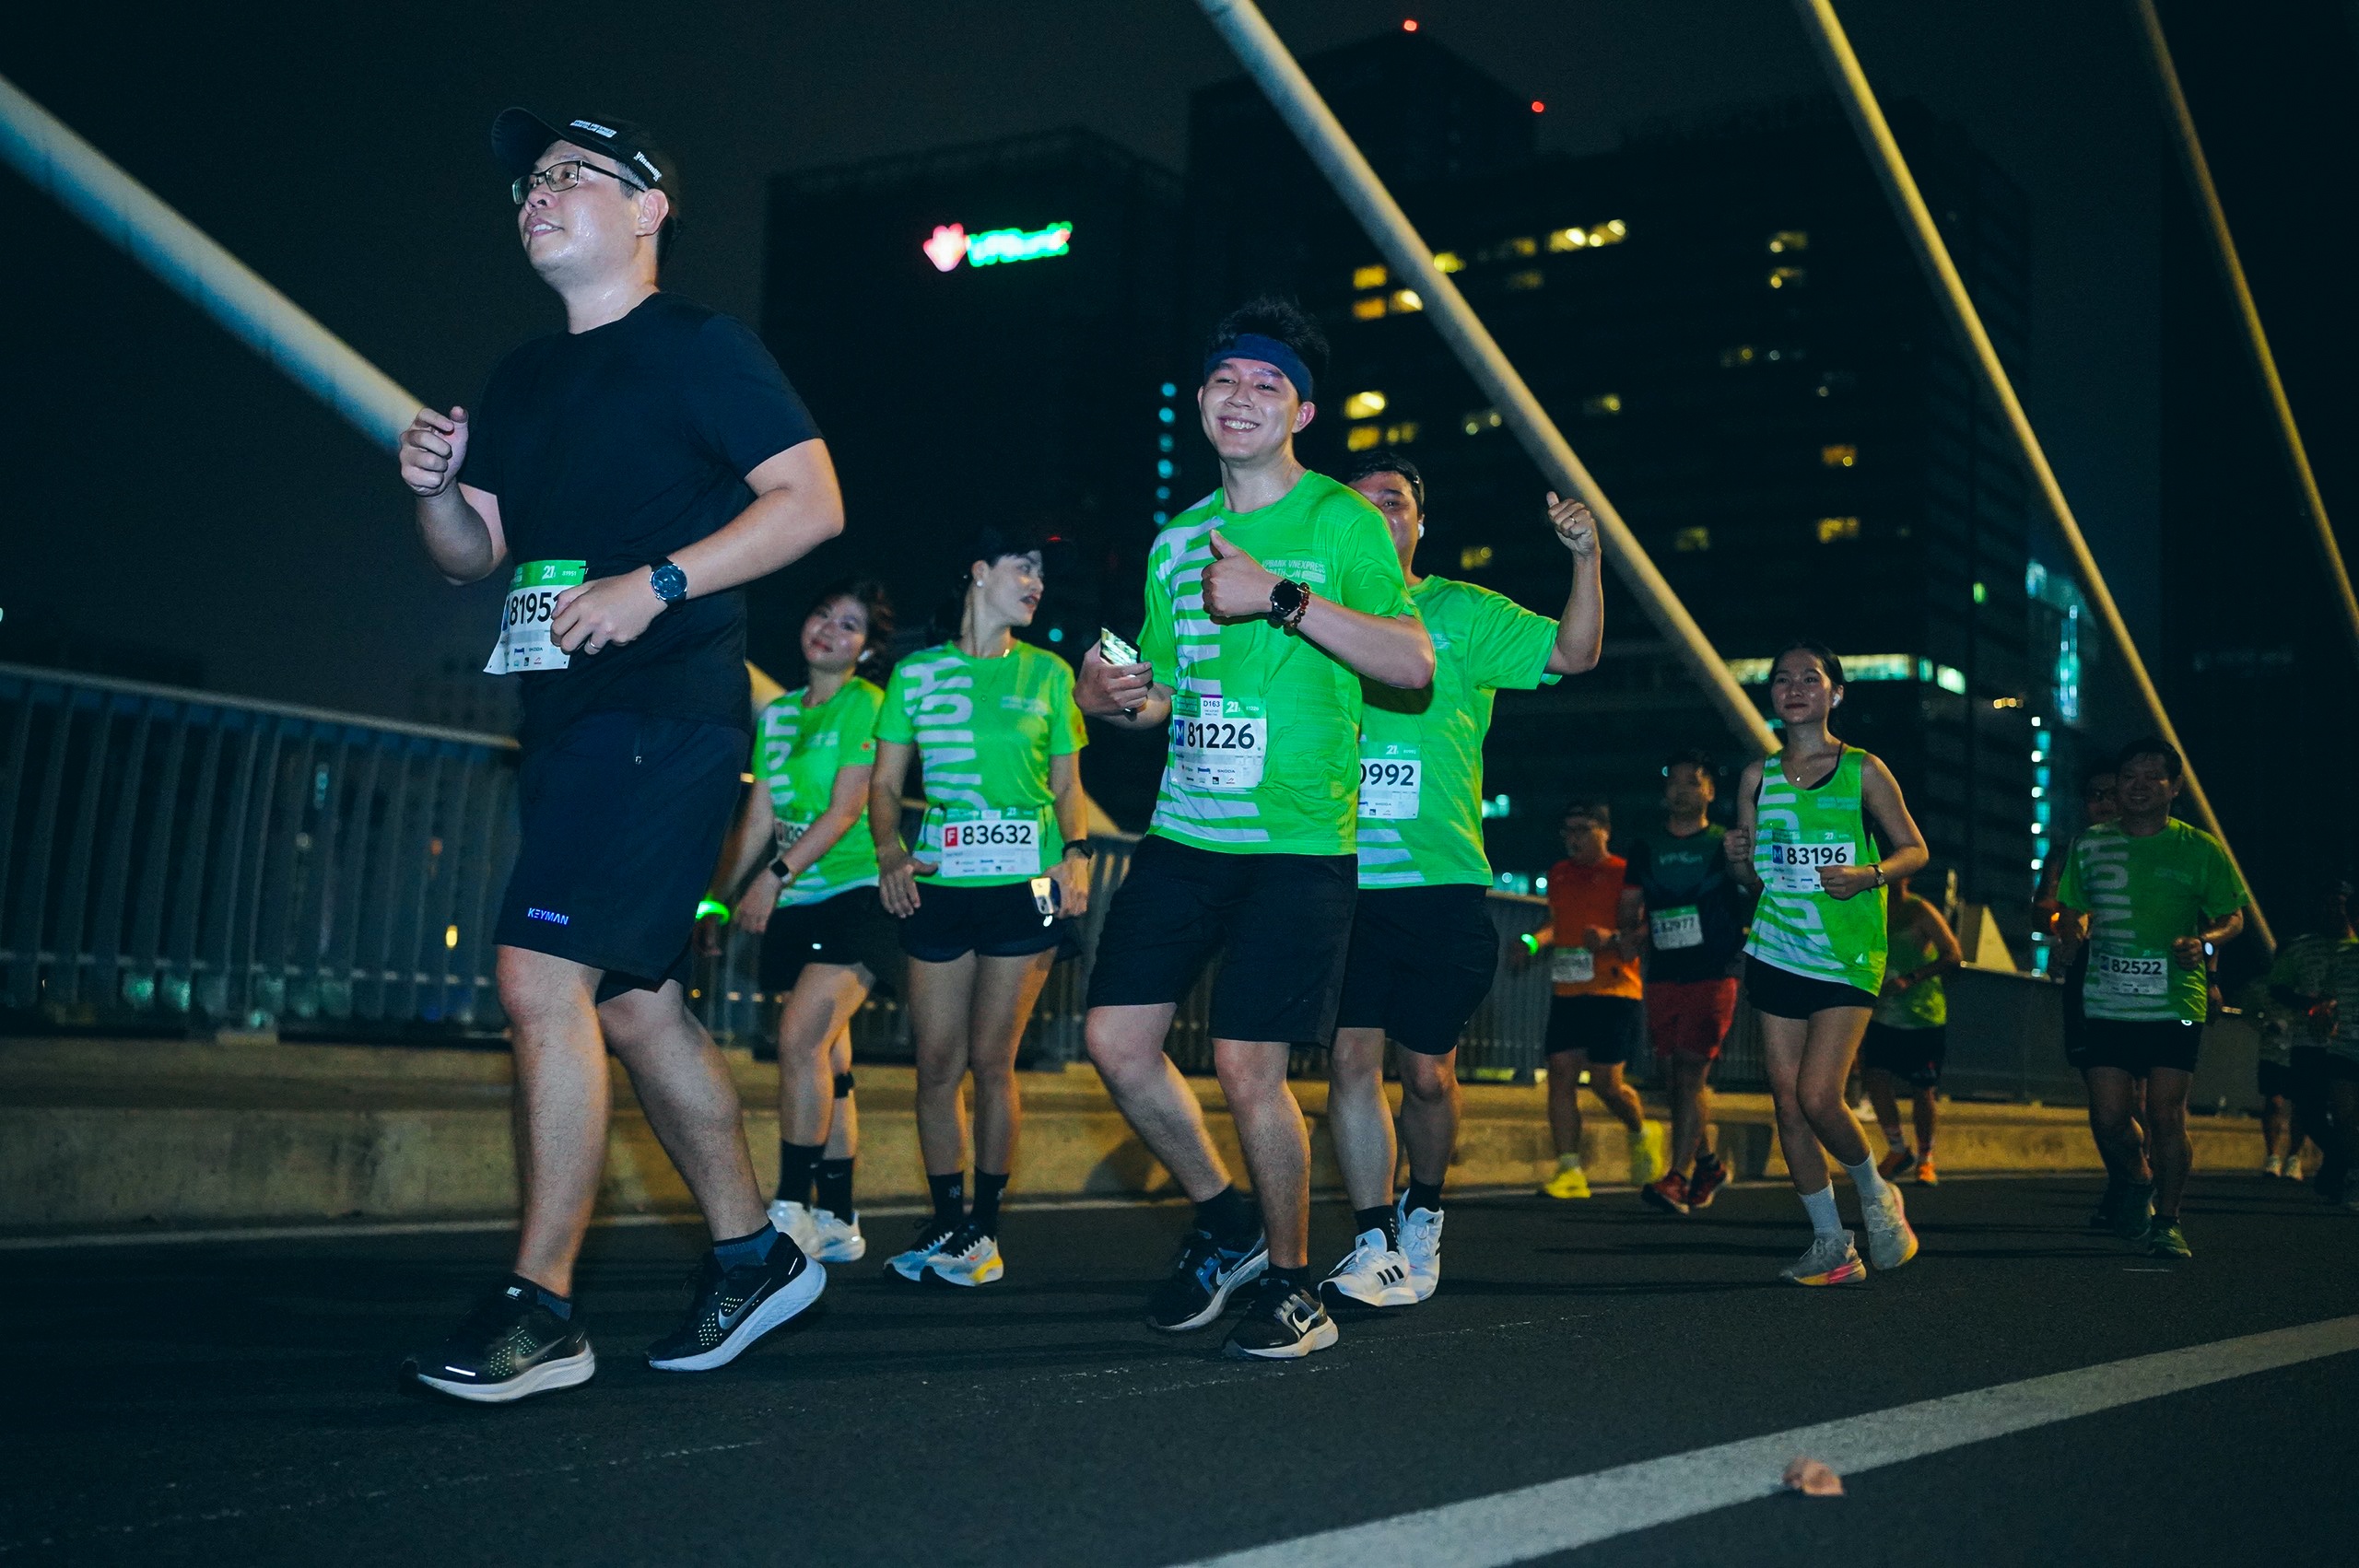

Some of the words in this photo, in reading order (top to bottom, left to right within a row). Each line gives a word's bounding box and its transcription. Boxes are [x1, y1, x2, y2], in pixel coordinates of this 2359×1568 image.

[542, 565, 555, 579] 21
[509, 591, 560, 626] 8195
[1226, 701, 1239, 714] 21
[1187, 721, 1255, 750] 81226
[946, 828, 956, 844] F
[962, 825, 1032, 845] 83632
[1787, 846, 1848, 865] 83196
[527, 907, 569, 926] KEYMAN
[2111, 958, 2163, 976] 82522
